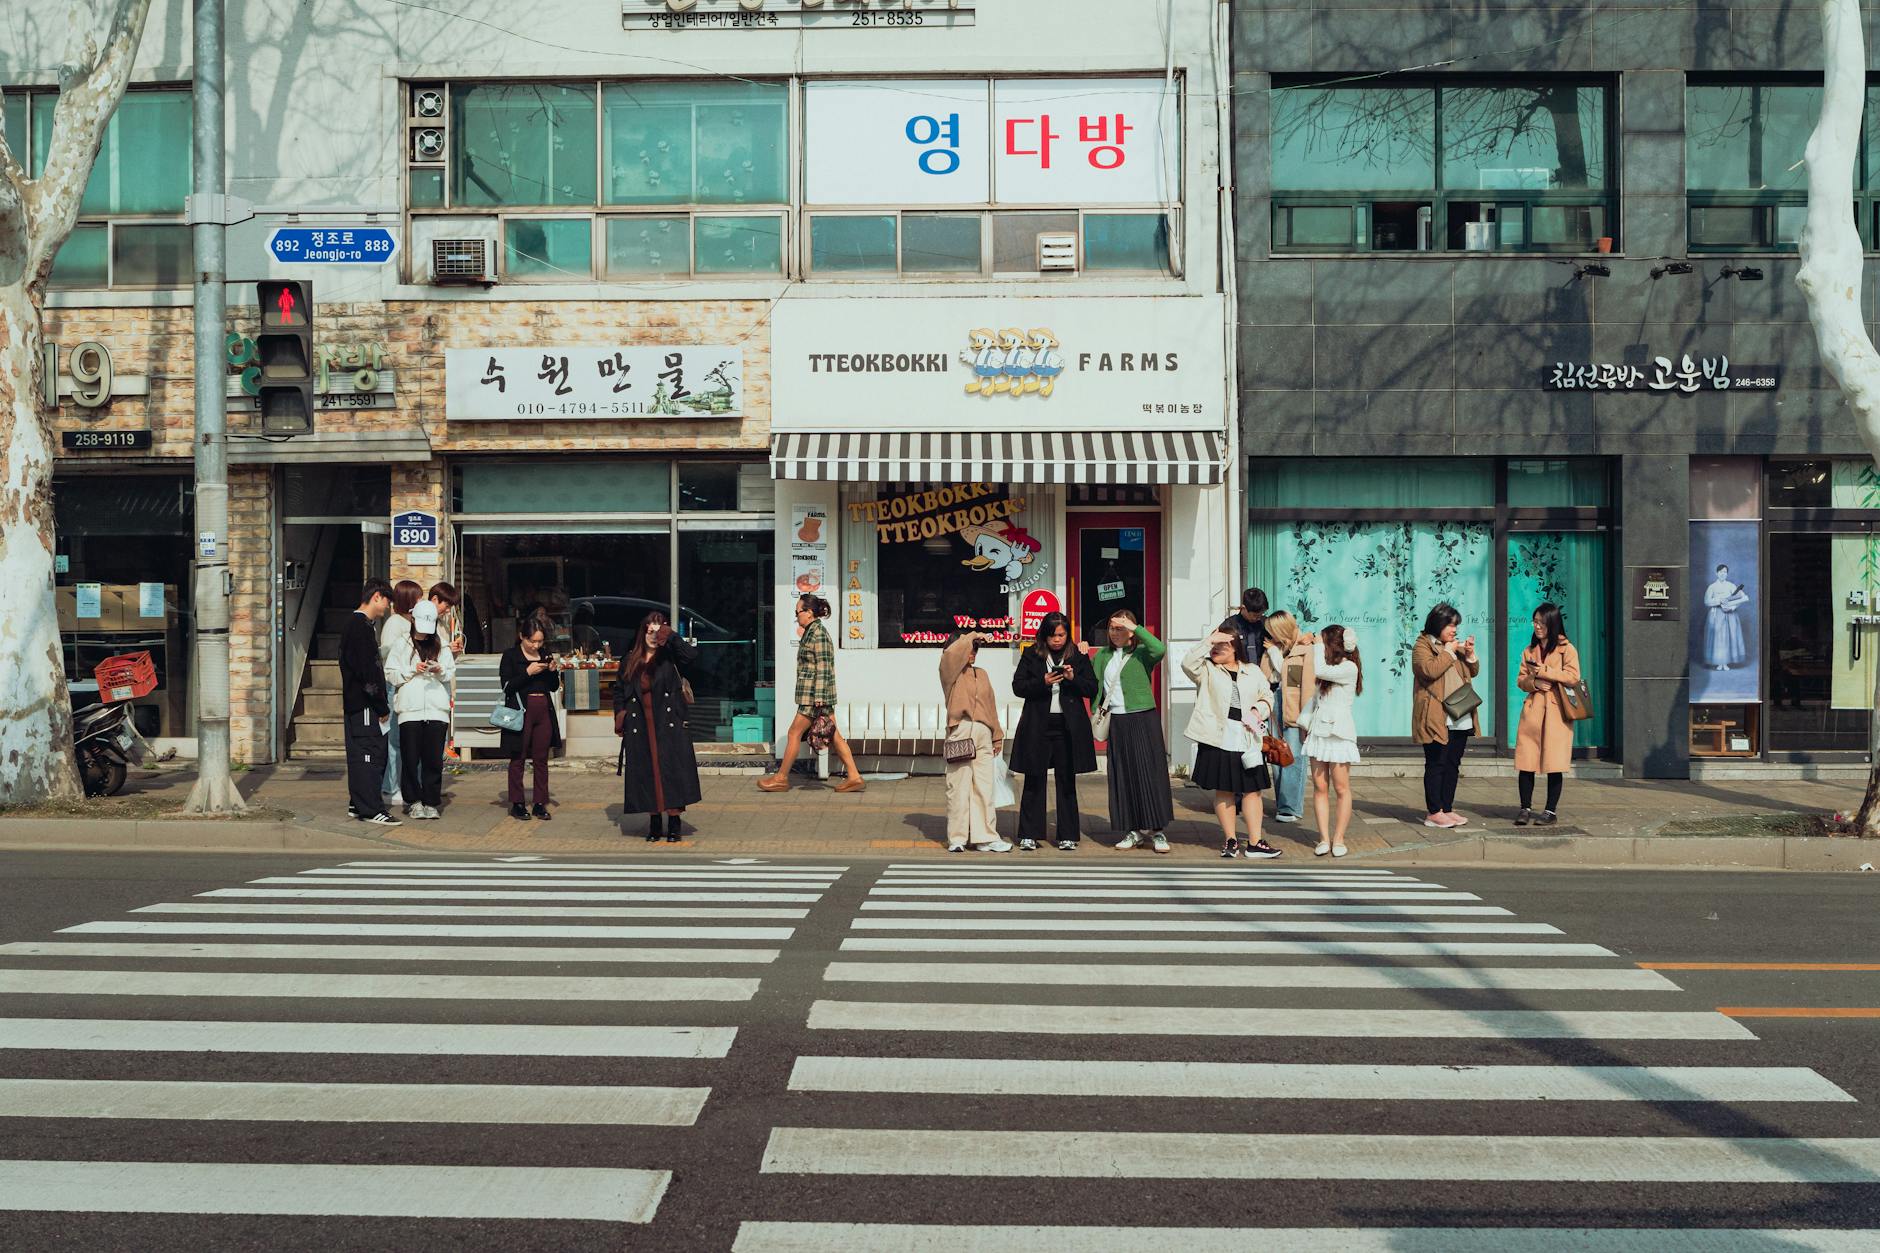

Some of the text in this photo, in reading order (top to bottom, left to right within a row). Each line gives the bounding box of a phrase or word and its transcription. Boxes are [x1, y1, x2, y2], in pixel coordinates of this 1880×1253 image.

[648, 11, 779, 28] 상업인테리어/일반건축
[852, 11, 924, 26] 251-8535
[276, 240, 300, 252] 892
[311, 232, 355, 248] 정조로
[364, 240, 389, 252] 888
[304, 249, 362, 261] Jeongjo-ro
[808, 352, 1180, 373] TTEOKBOKKI FARMS
[1550, 361, 1645, 389] 침선공방
[1735, 378, 1777, 388] 246-6358
[321, 394, 377, 407] 241-5591
[516, 402, 645, 415] 010-4794-5511
[1142, 403, 1204, 415] 떡볶이농장
[75, 433, 135, 446] 258-9119
[400, 528, 431, 544] 890
[999, 561, 1050, 594] Delicious
[953, 615, 977, 628] We
[1024, 617, 1044, 631] ZO
